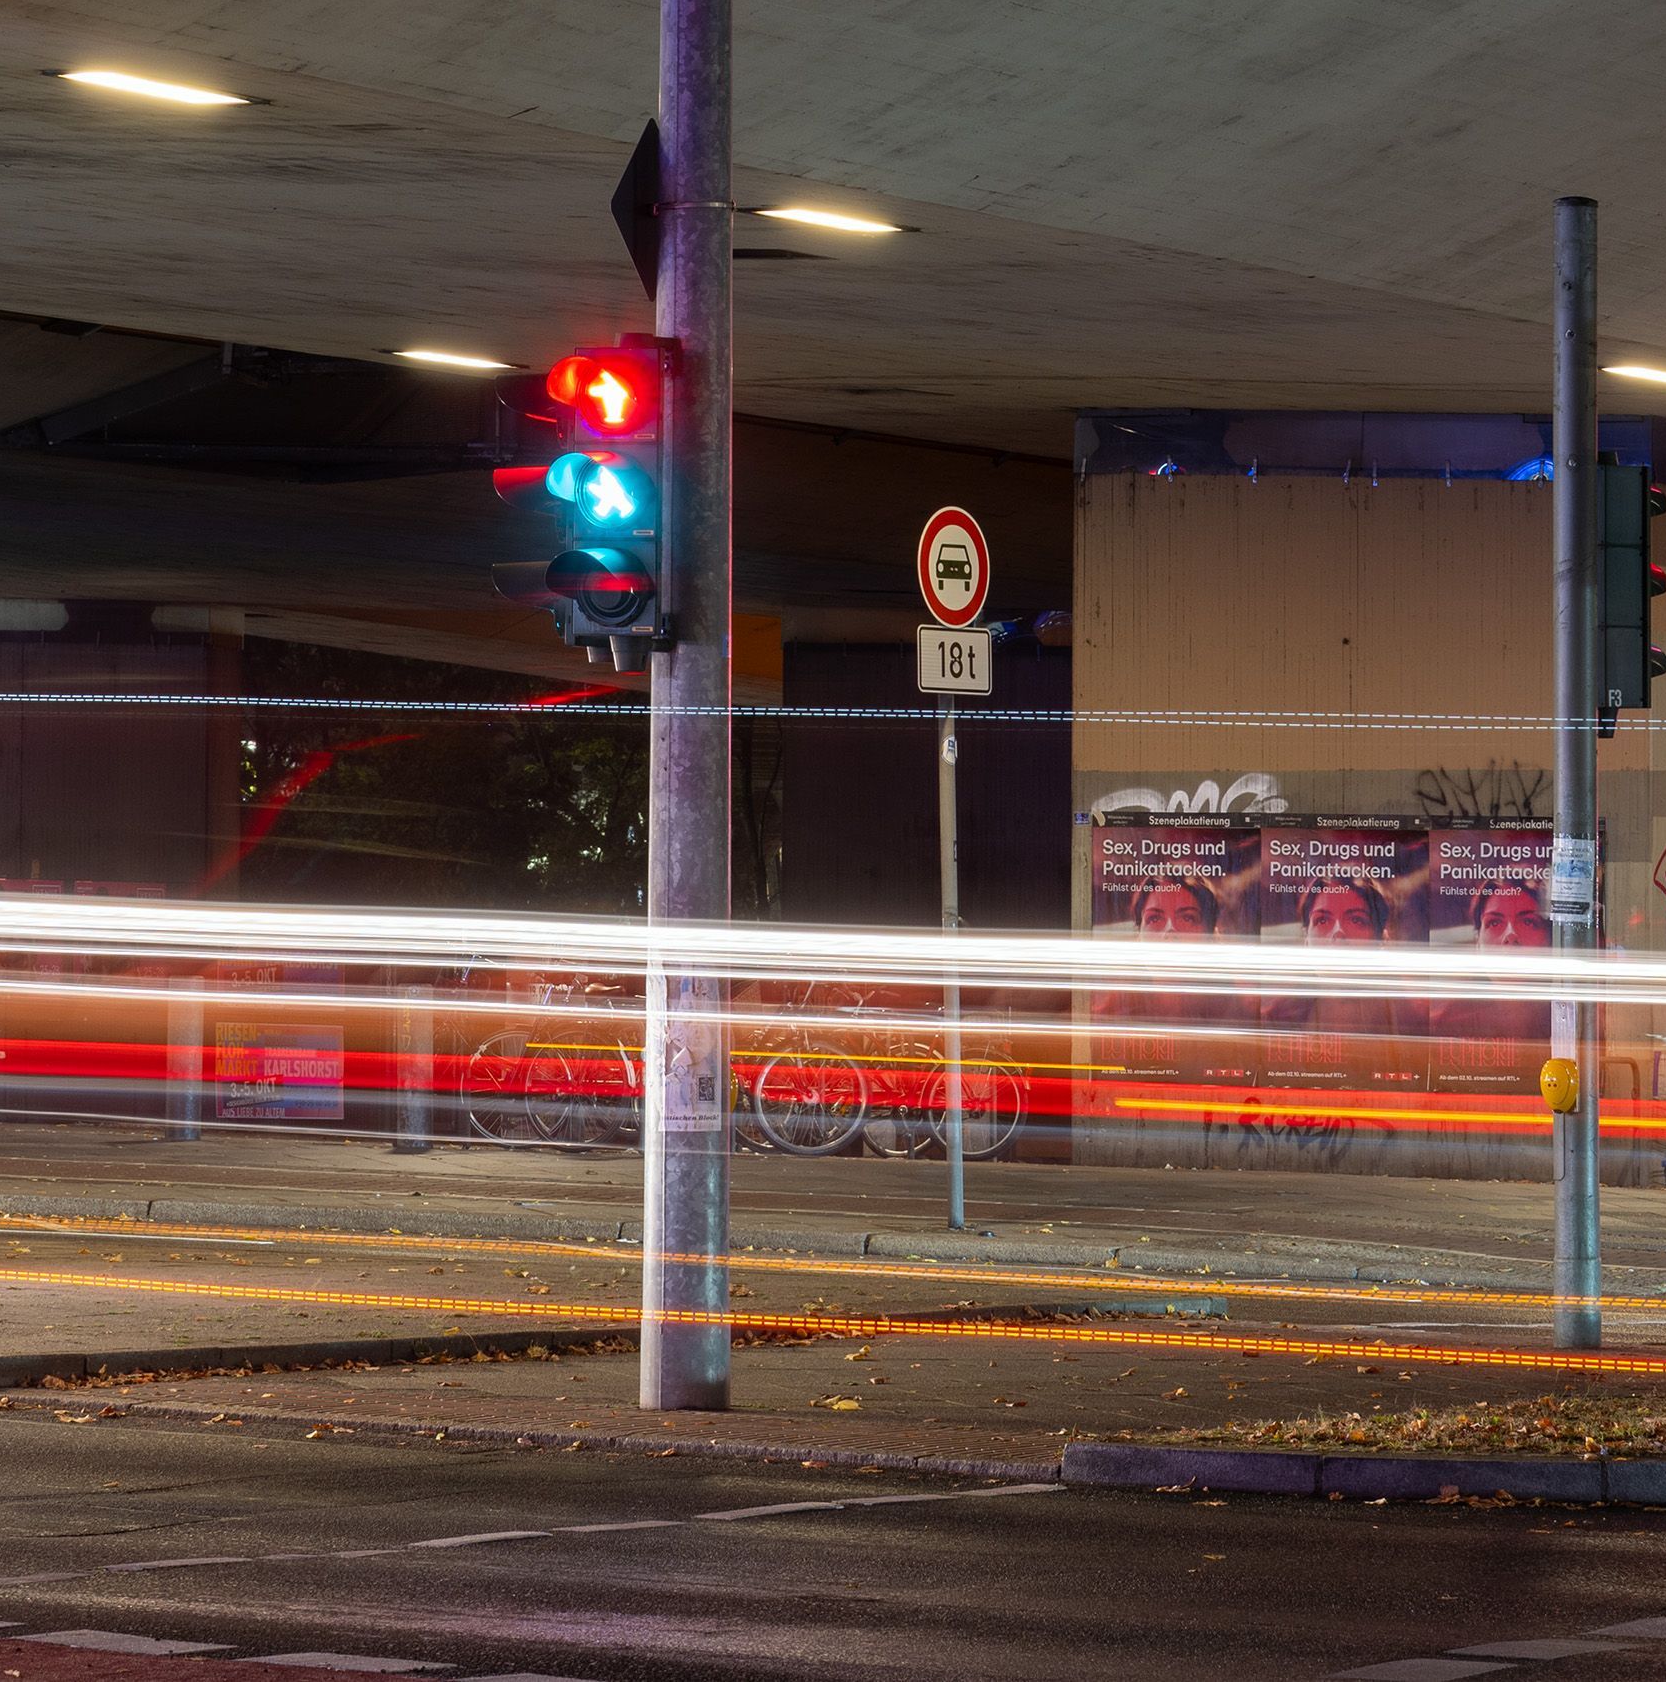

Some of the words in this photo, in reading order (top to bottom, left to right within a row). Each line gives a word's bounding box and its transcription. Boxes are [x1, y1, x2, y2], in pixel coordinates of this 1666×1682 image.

[1148, 815, 1230, 827] Szeneplakatierung
[1316, 816, 1400, 829] Szeneplakatierung
[1489, 819, 1553, 830] Szeneplakatie
[1102, 839, 1138, 858] Sex,
[1141, 839, 1191, 859] Drugs
[1195, 840, 1226, 855] und
[1269, 840, 1305, 858] Sex,
[1309, 841, 1360, 860] Drugs
[1363, 842, 1395, 857] und
[1440, 842, 1476, 860] Sex,
[1480, 843, 1532, 862] Drugs
[1102, 860, 1226, 877] Panikattacken.
[1269, 861, 1395, 879] Panikattacken.
[1440, 864, 1550, 880] Panikattacke
[1102, 882, 1129, 893] Fühlst
[1130, 883, 1142, 892] du
[1155, 883, 1181, 893] auch?
[1269, 883, 1297, 893] Fühlst
[1298, 884, 1309, 893] du
[1311, 886, 1321, 894] es
[1323, 884, 1350, 894] auch?
[1440, 886, 1467, 895] Fühlst
[1469, 886, 1480, 895] du
[1482, 888, 1493, 896] es
[1494, 887, 1522, 896] auch?
[263, 1059, 339, 1078] KARLSHORST
[256, 1077, 277, 1094] OKT
